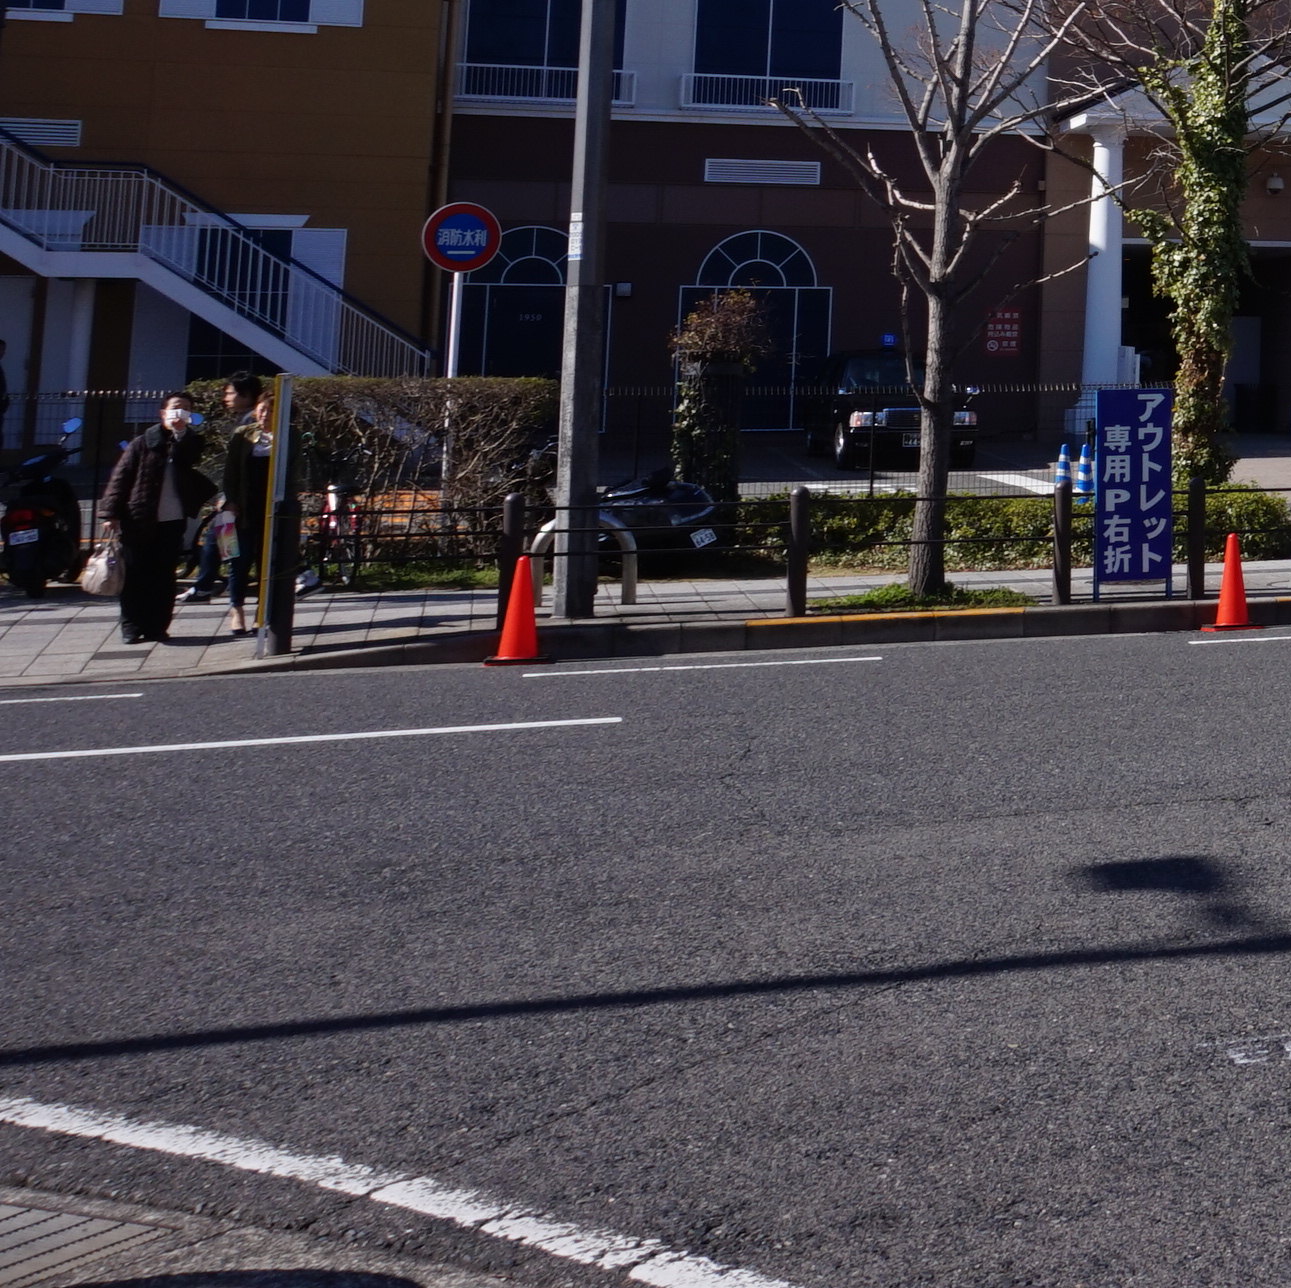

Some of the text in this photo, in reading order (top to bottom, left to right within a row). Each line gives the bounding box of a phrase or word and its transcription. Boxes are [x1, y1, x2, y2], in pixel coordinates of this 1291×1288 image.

[438, 228, 488, 247] 消防水利
[1103, 424, 1133, 575] 専用P右折
[1137, 393, 1168, 573] アウトレット
